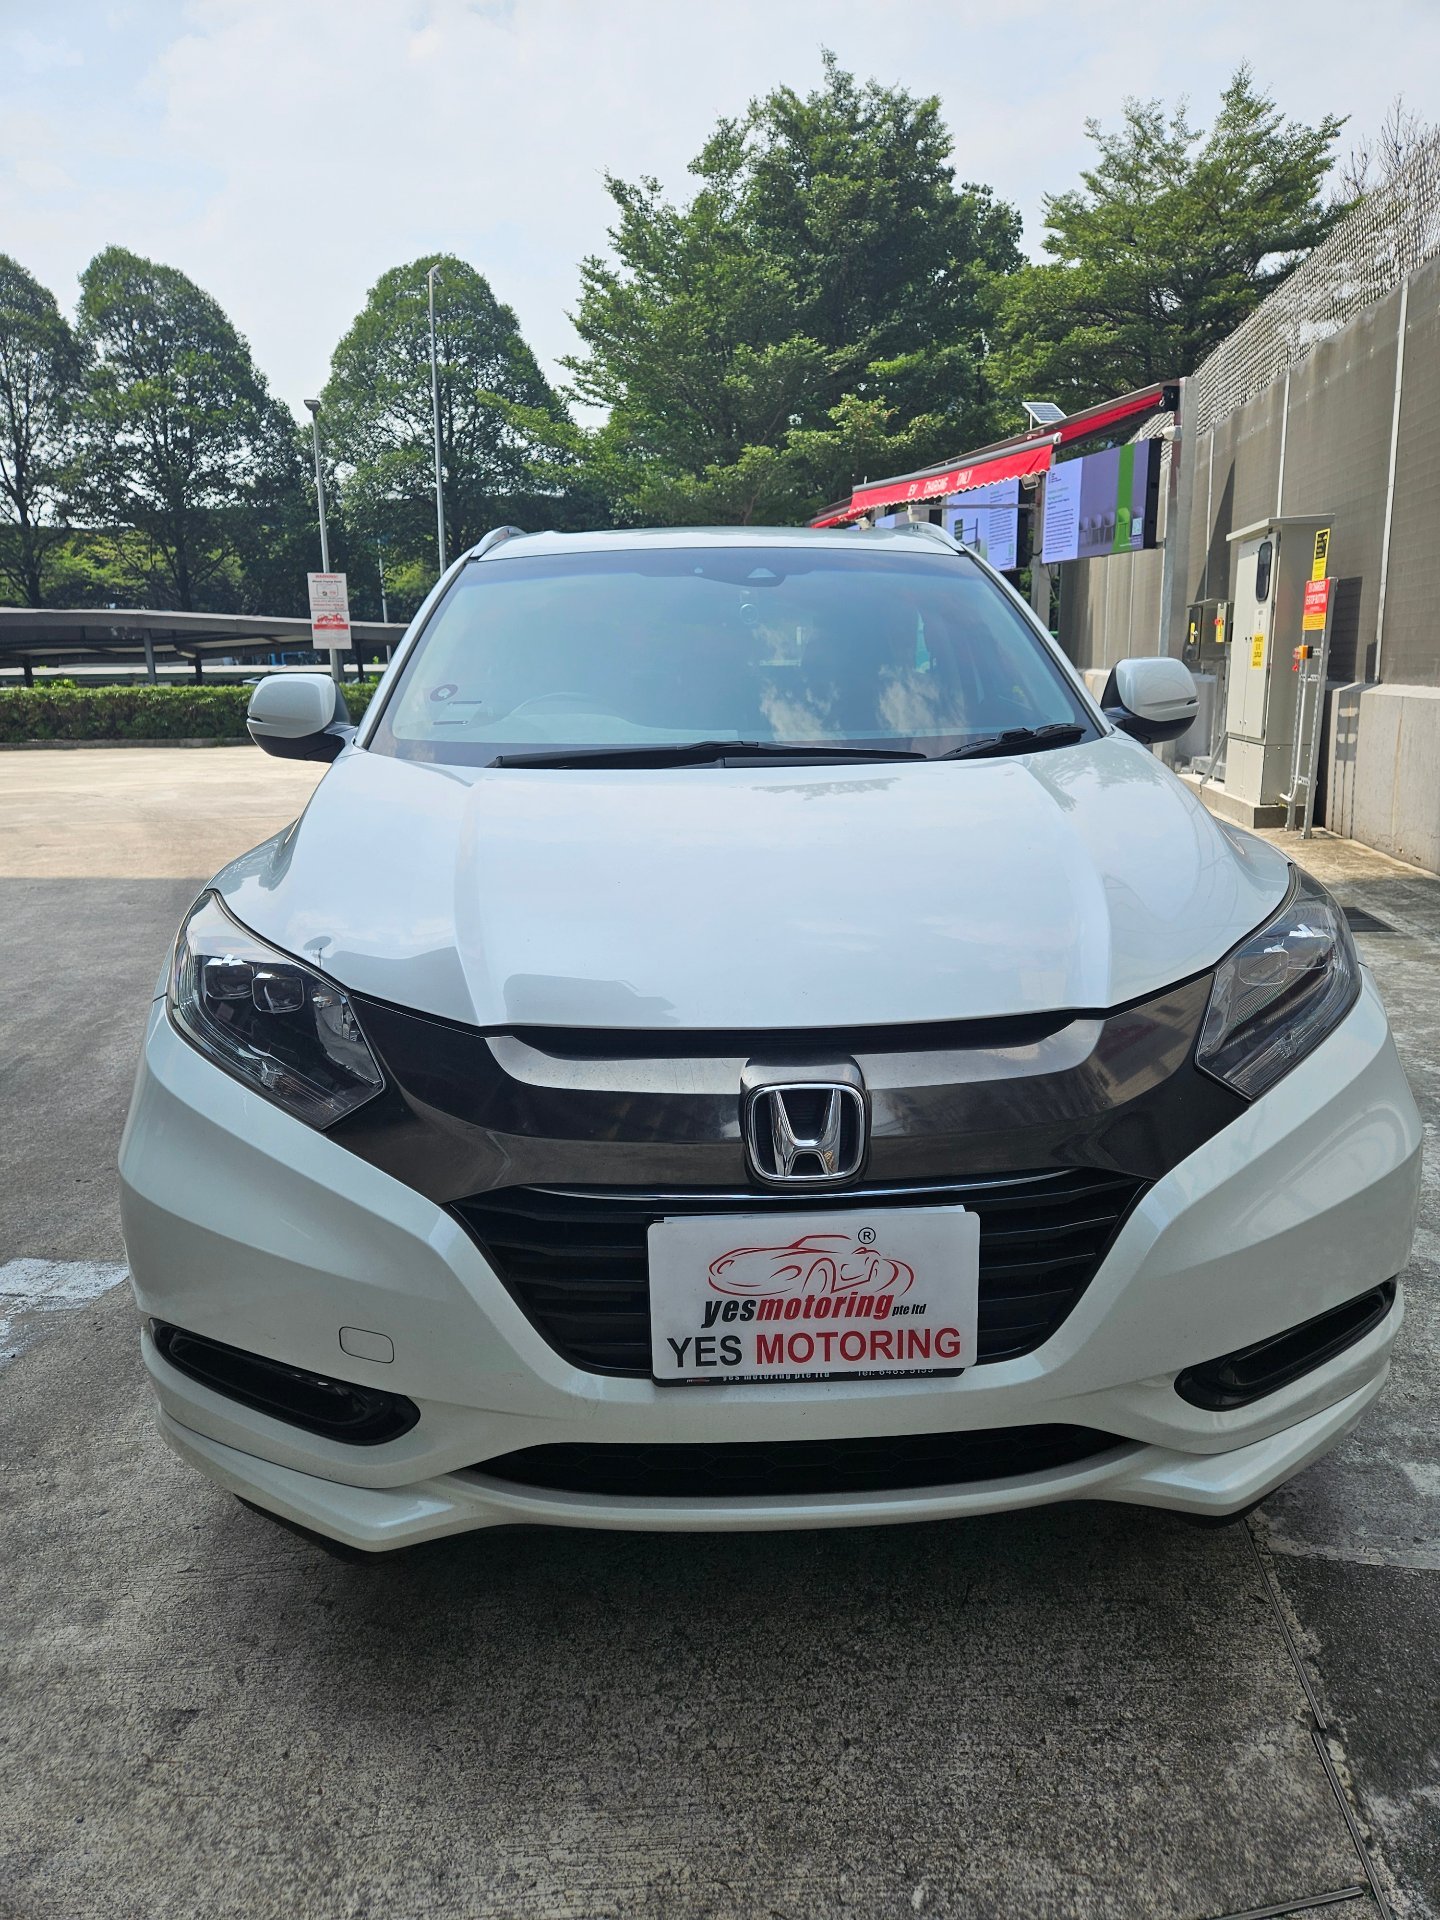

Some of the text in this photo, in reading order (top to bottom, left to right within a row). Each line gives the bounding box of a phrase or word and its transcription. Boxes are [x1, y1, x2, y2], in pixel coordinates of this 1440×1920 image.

[700, 1291, 927, 1329] yesmotoring pte ltd
[667, 1327, 961, 1368] YES MOTORING
